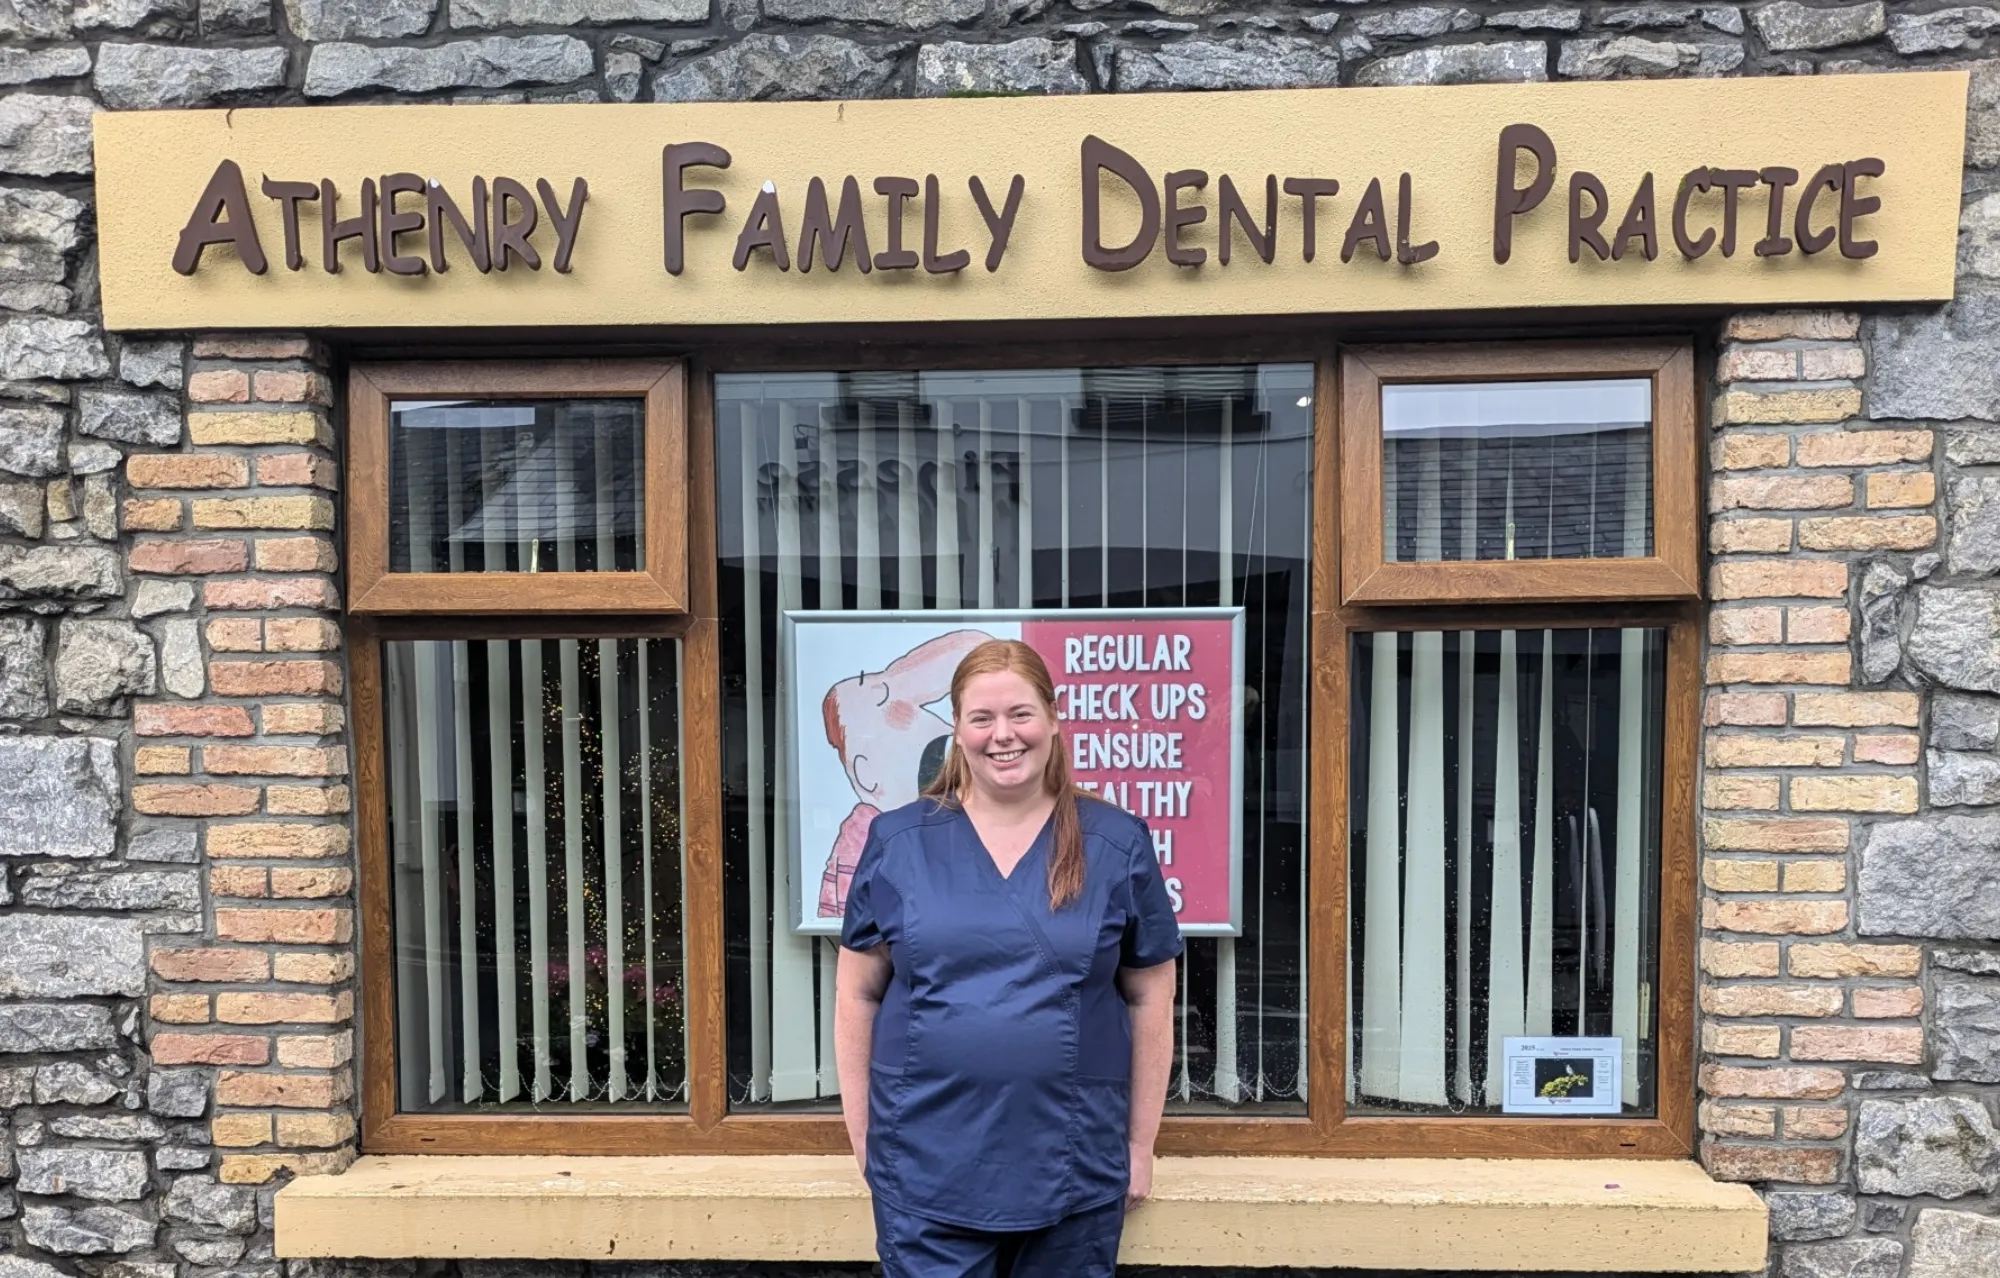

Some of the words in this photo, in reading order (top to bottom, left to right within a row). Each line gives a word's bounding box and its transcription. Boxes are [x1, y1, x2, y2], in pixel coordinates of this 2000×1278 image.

[172, 158, 588, 276] ATHENRY
[662, 141, 1025, 276] FAMILY
[1081, 134, 1440, 272] DENTAL
[1493, 123, 1886, 265] PRACTICE
[1065, 634, 1191, 674] REGULAR
[1054, 683, 1140, 720] CHECK
[1151, 683, 1206, 720] UPS
[1073, 732, 1183, 769] ENSURE
[1076, 781, 1192, 817] ALTHY
